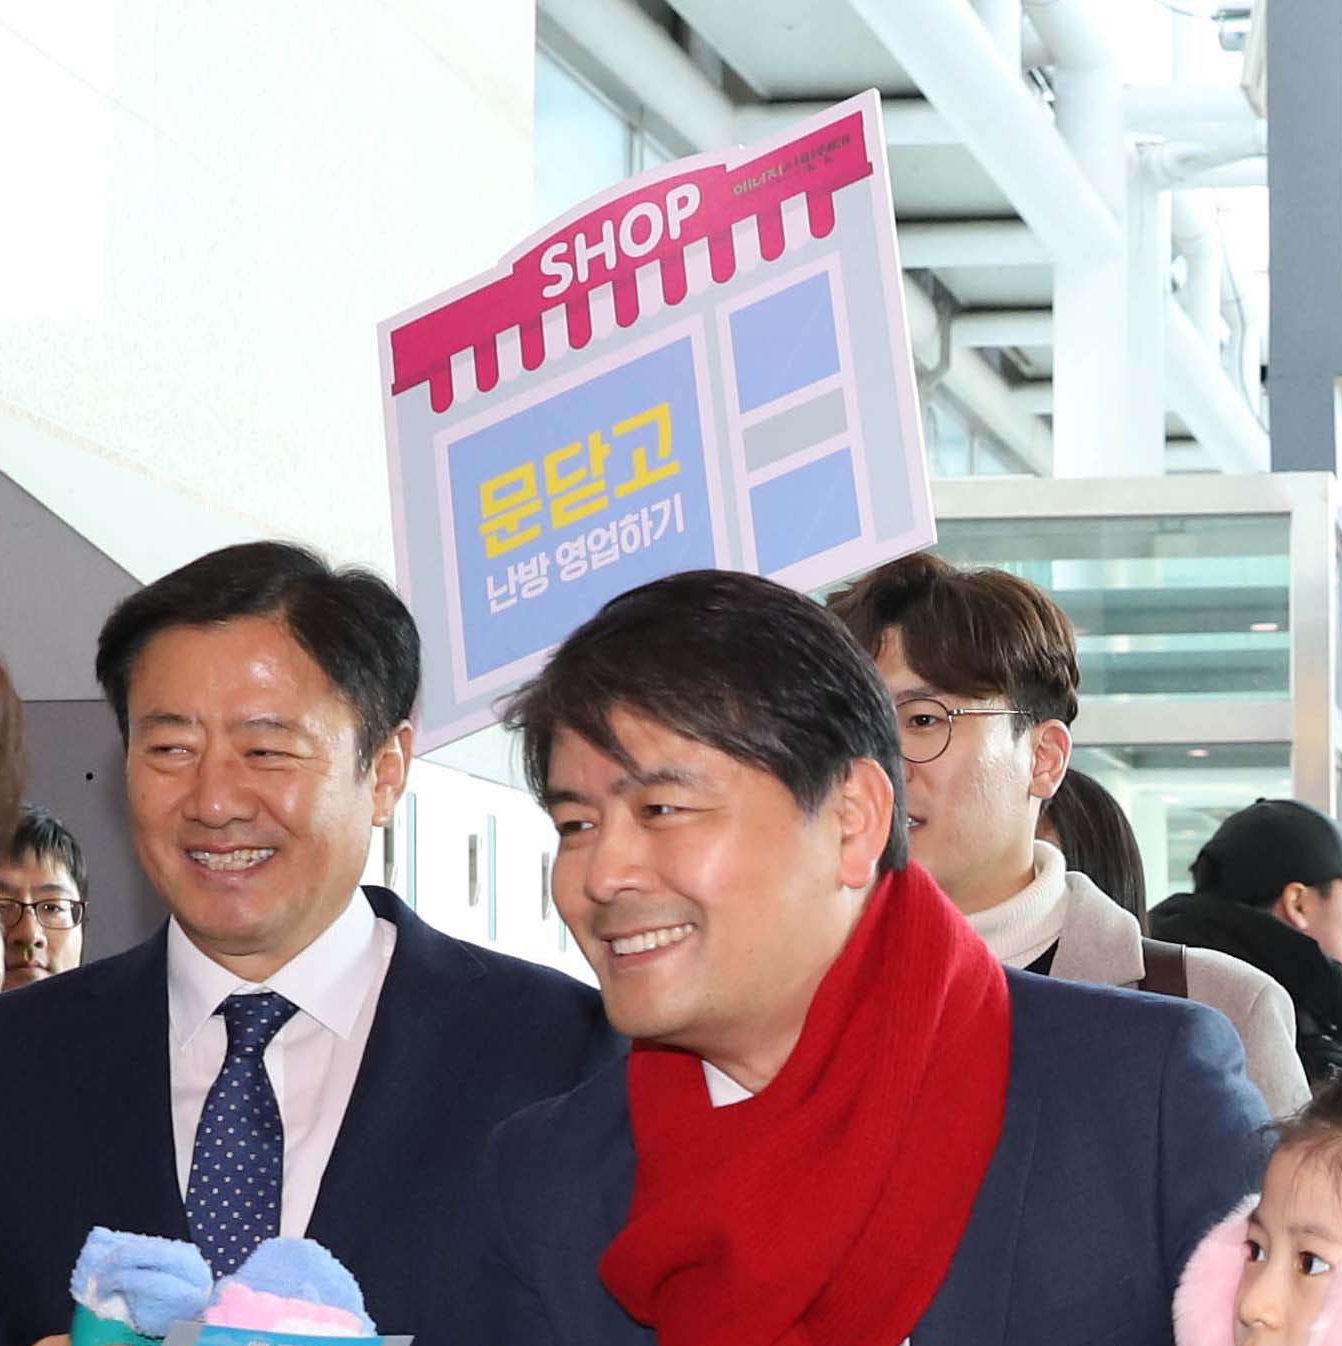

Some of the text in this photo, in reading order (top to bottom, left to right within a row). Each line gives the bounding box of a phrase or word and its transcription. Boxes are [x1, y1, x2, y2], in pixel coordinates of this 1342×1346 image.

[540, 182, 703, 299] SHOP
[479, 402, 682, 559] 문닫고
[486, 493, 684, 616] 난방 영업하기
